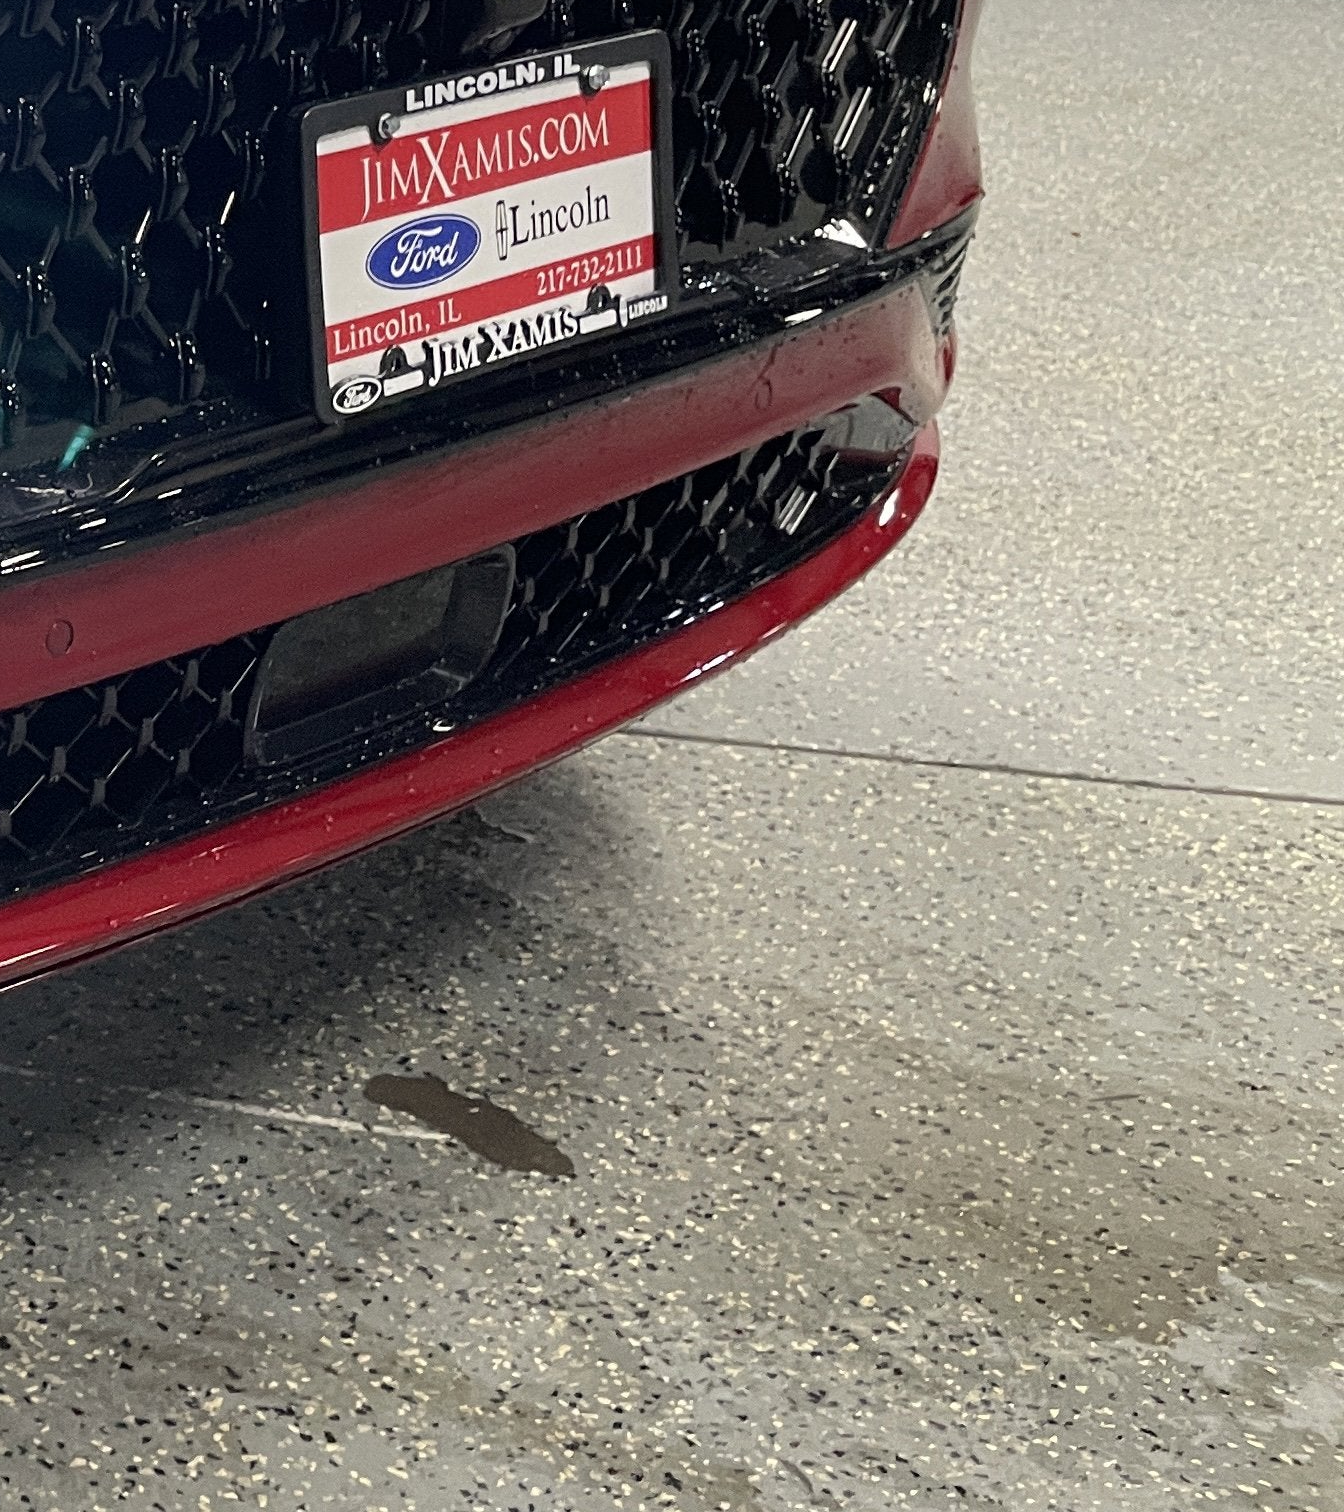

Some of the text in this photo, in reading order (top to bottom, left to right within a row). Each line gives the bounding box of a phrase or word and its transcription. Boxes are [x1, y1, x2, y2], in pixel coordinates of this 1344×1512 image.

[406, 53, 582, 112] LINCOLN, IL
[509, 185, 611, 248] Lincoln
[390, 226, 458, 278] Ford
[536, 245, 644, 297] 217-732-2111
[333, 297, 463, 356] Lincoln, IL
[485, 309, 580, 363] XAMIS
